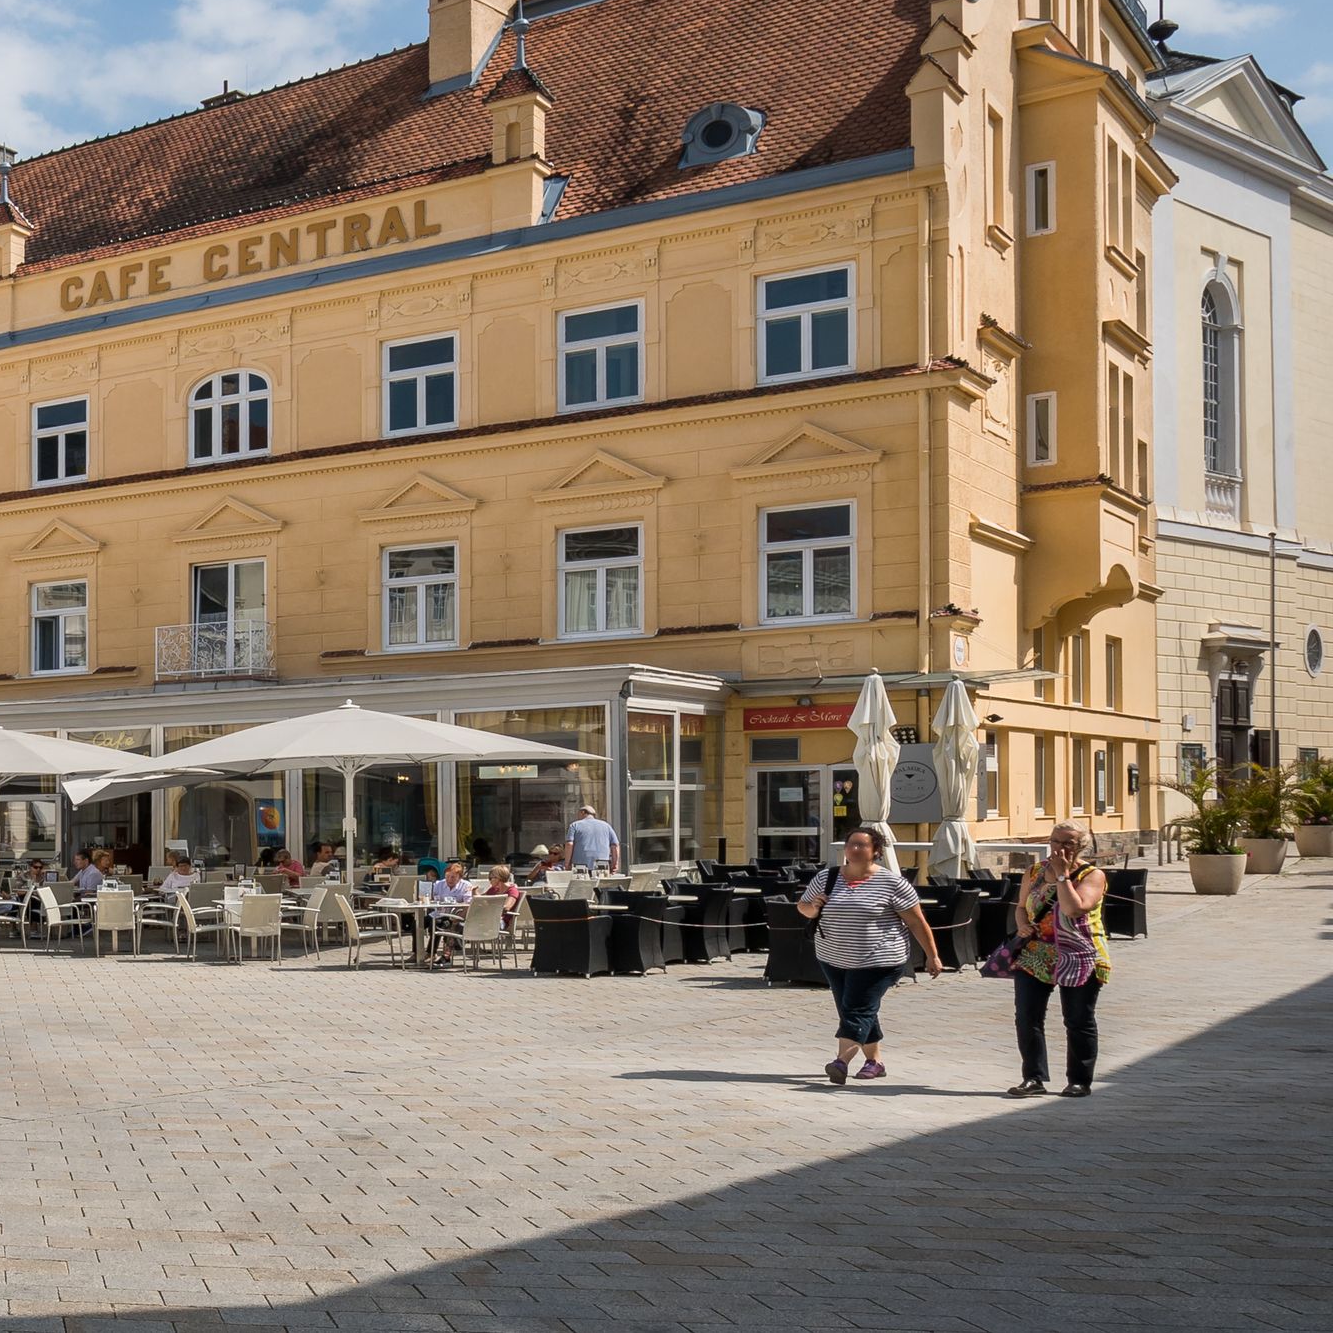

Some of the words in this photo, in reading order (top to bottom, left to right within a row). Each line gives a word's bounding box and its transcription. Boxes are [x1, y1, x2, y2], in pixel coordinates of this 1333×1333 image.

[60, 255, 171, 313] CAFE
[203, 200, 442, 282] CENTRAL
[749, 713, 791, 725] Cocktails
[809, 710, 842, 722] More
